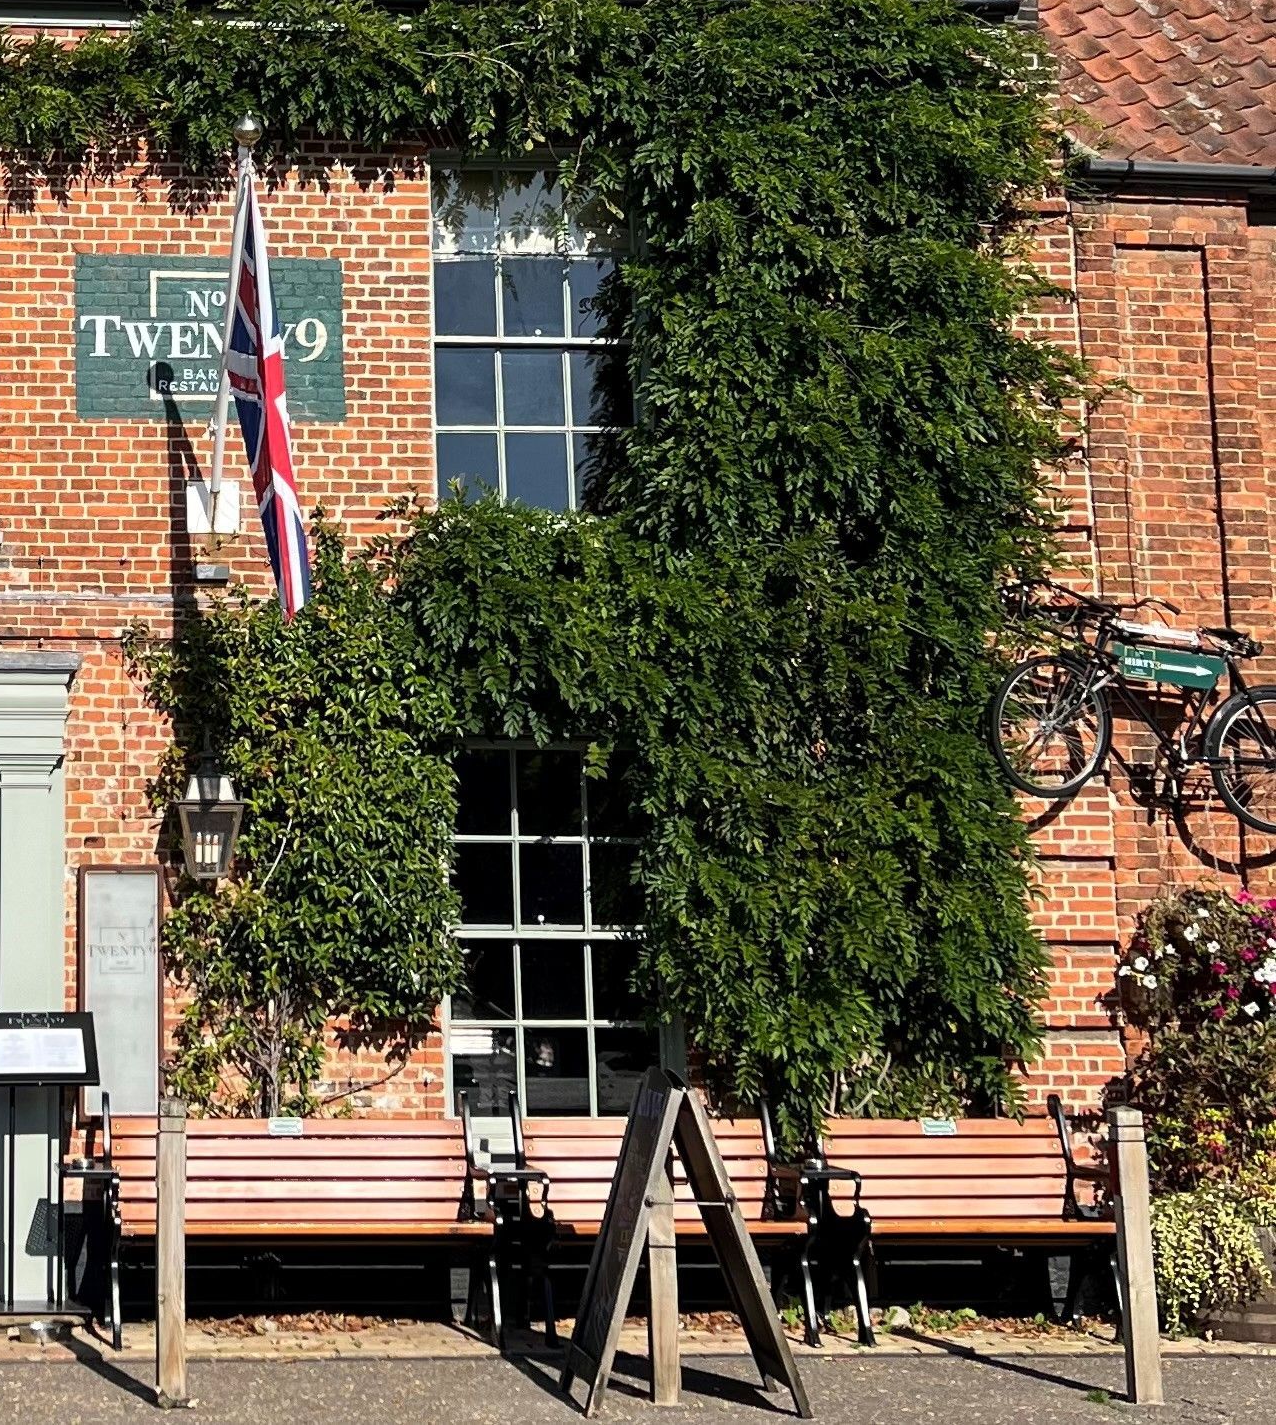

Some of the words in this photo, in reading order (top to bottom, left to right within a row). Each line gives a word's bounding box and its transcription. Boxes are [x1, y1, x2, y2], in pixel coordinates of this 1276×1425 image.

[80, 315, 328, 362] TWENY9
[184, 369, 218, 380] BAR
[158, 380, 220, 392] RESTAU
